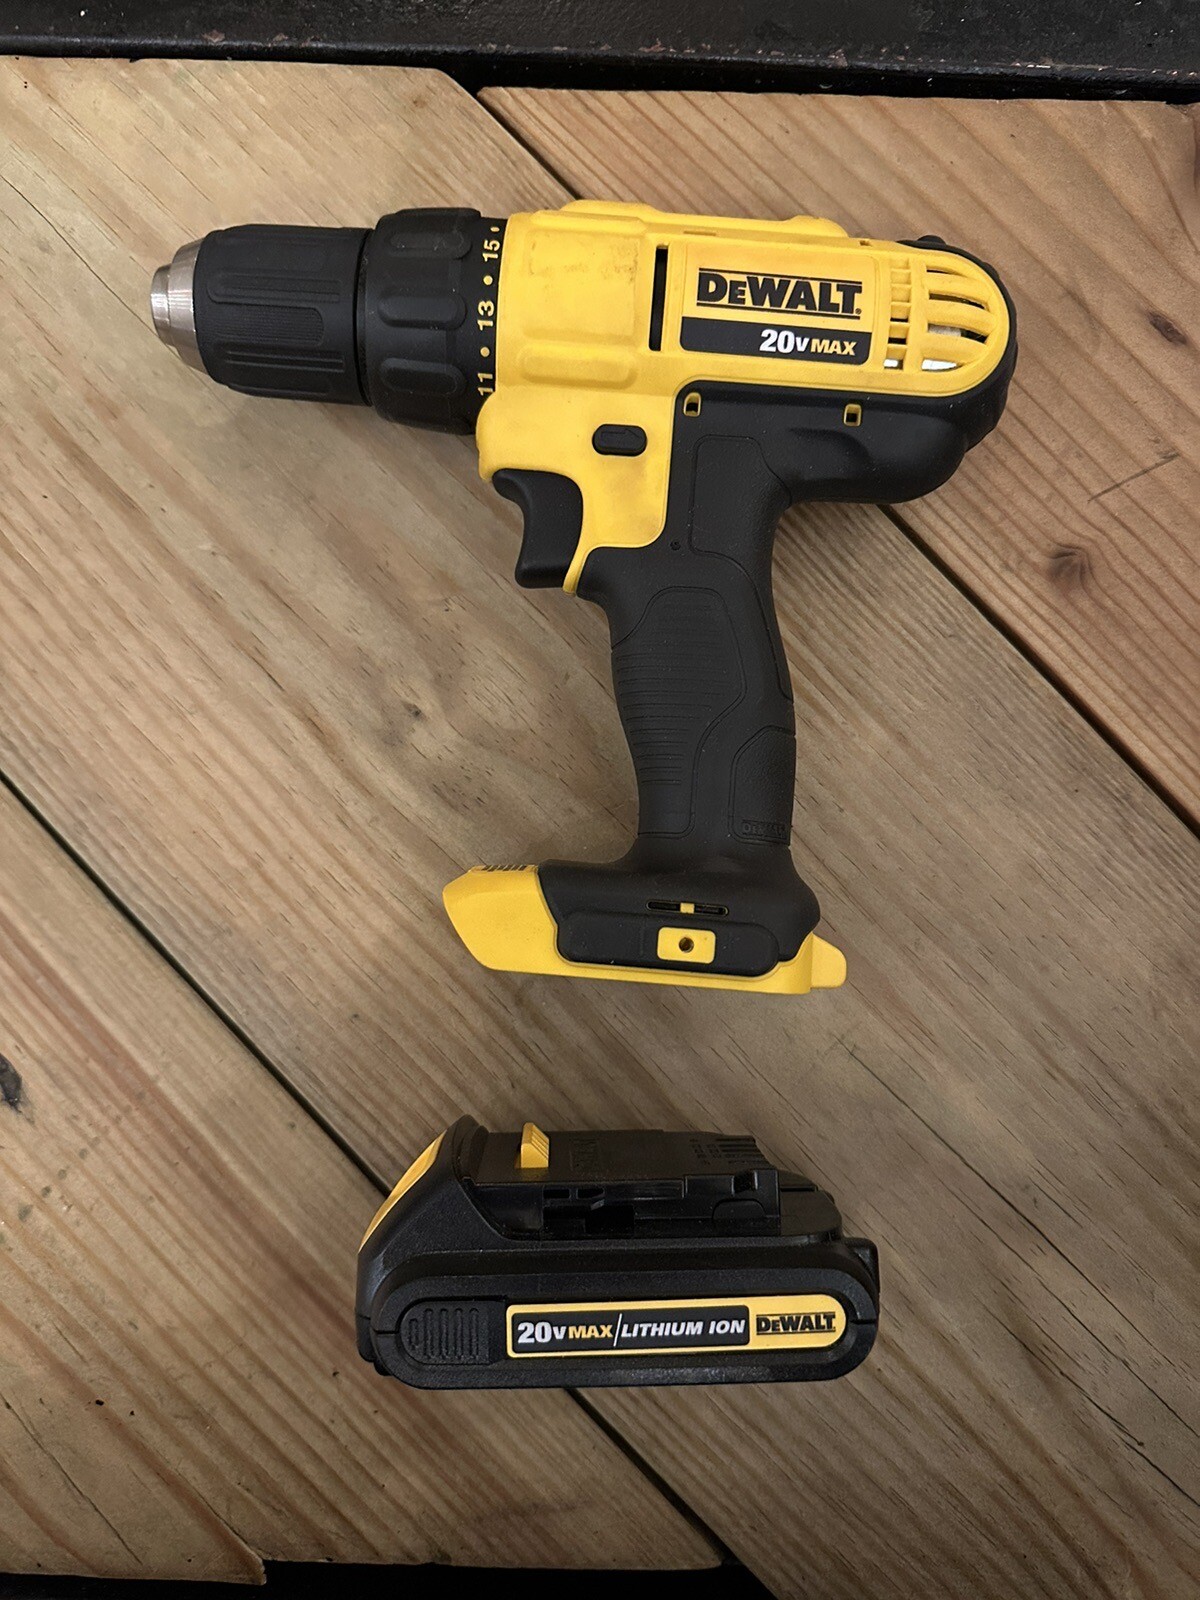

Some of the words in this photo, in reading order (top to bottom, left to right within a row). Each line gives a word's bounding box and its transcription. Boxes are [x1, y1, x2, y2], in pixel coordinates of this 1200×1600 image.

[482, 240, 500, 262] 15
[477, 300, 495, 331] 13
[810, 338, 857, 356] MAX
[477, 372, 493, 396] 11
[708, 1319, 746, 1335] ION
